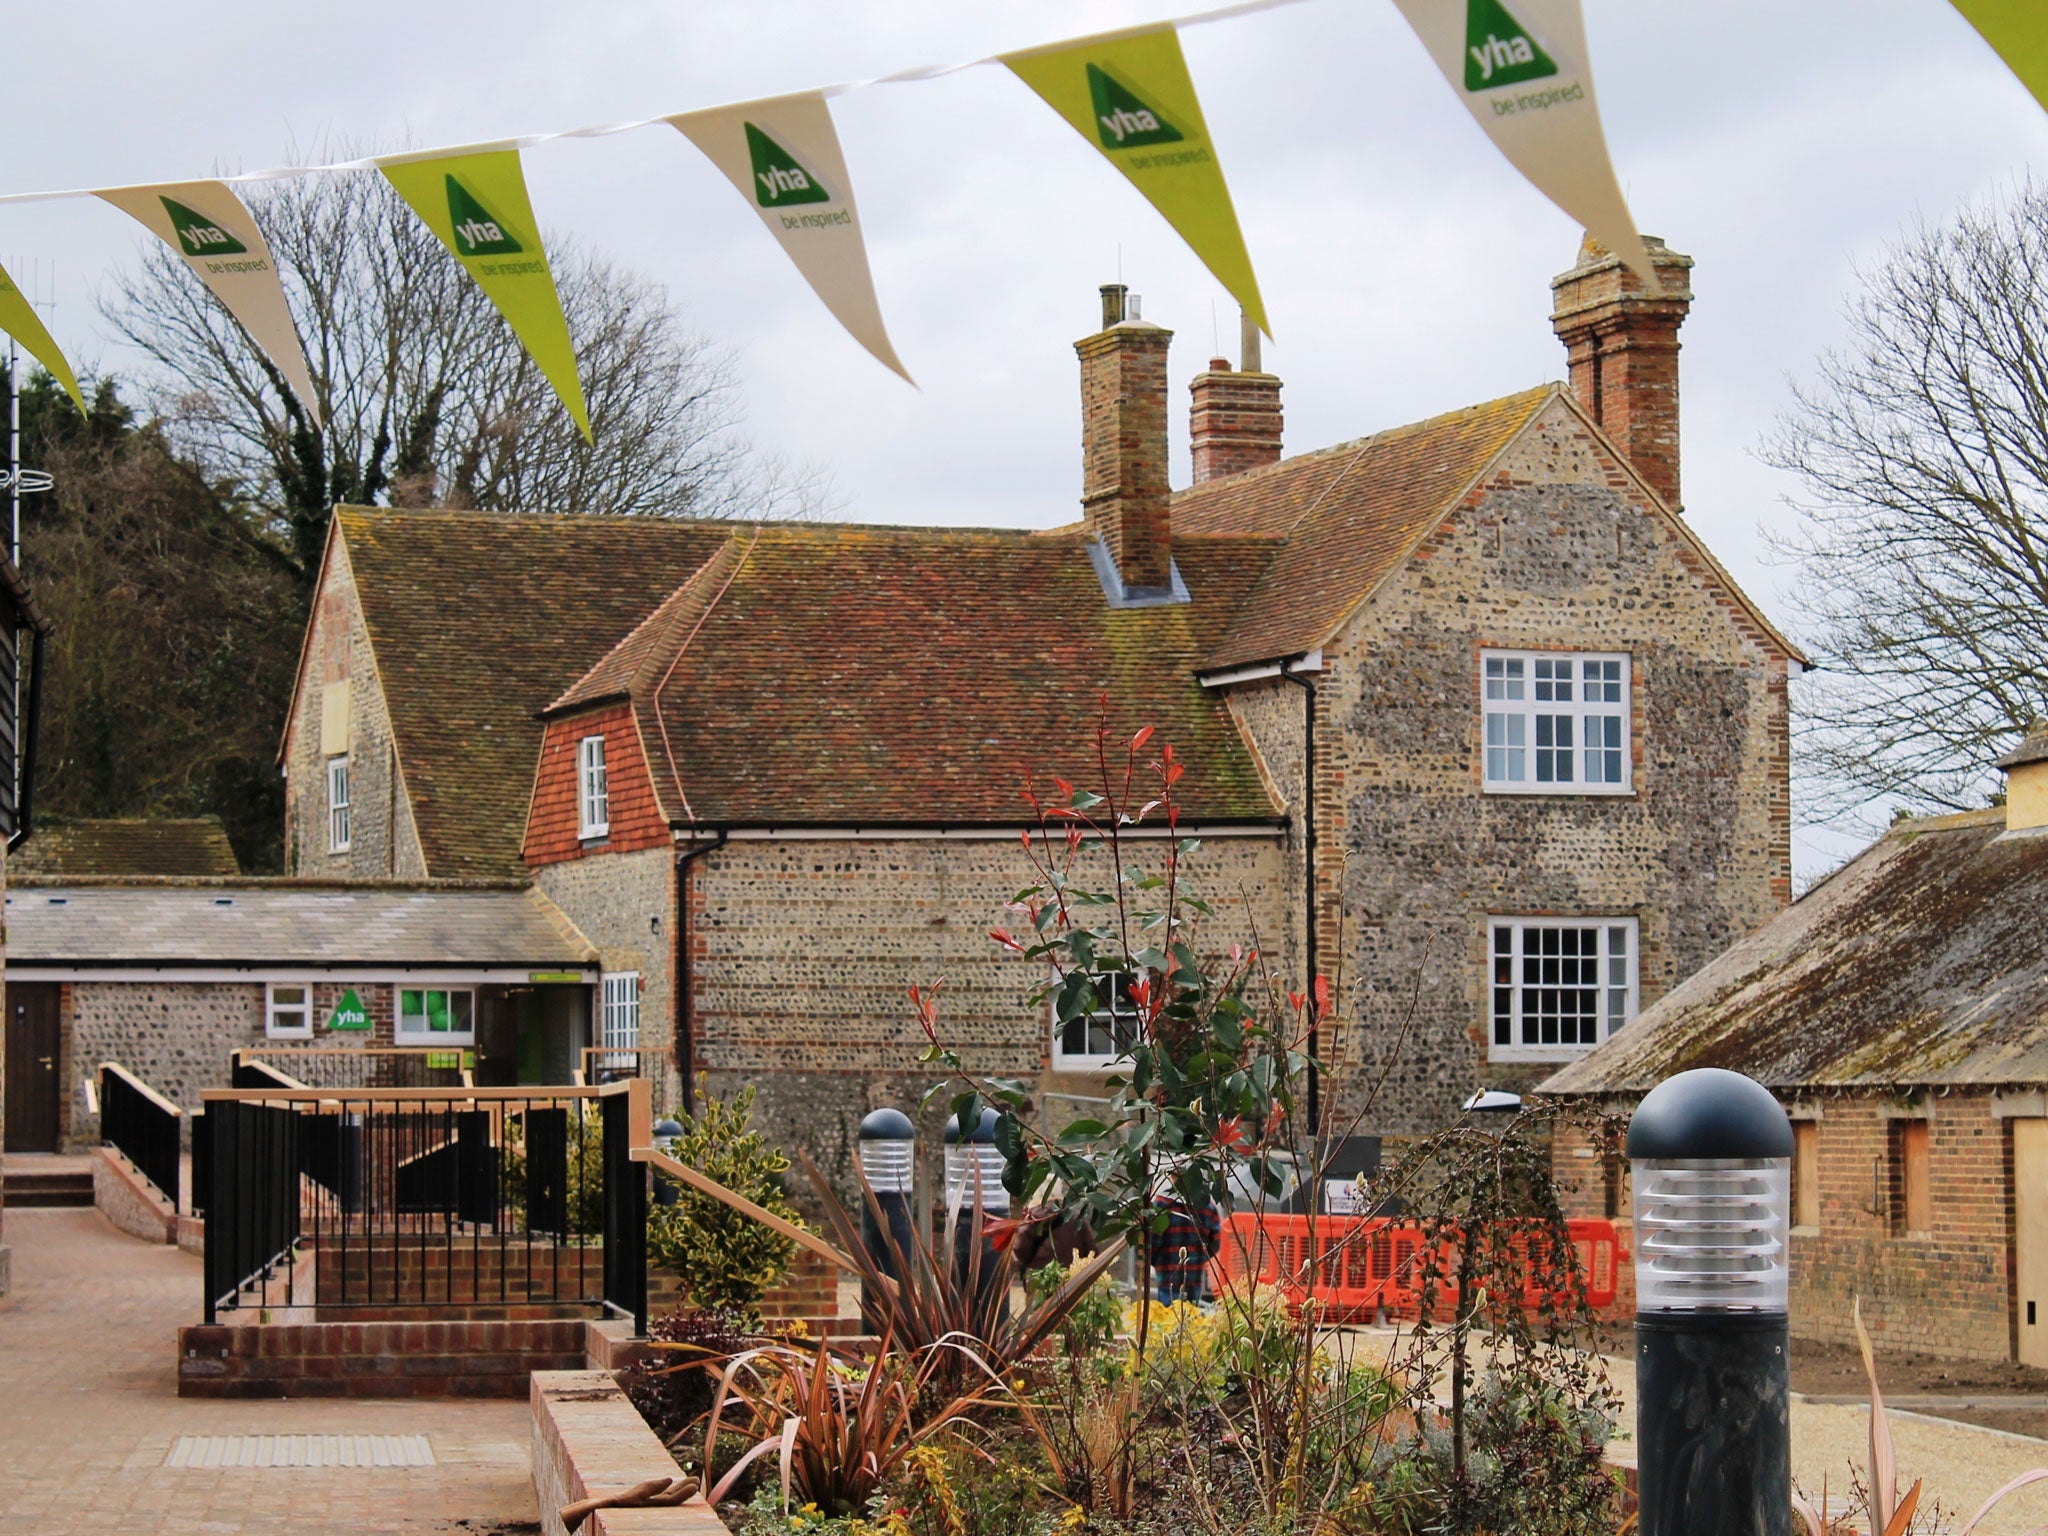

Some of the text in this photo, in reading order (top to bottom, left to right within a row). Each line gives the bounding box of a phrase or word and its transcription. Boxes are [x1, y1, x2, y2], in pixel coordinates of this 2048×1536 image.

[1471, 33, 1535, 79] yha
[1491, 80, 1584, 115] be inspired
[1101, 107, 1160, 141] yha
[1152, 148, 1209, 167] inspired
[758, 165, 810, 199] yha
[781, 208, 851, 229] be inspired
[180, 224, 228, 250] yha
[456, 218, 505, 249] yha
[205, 257, 269, 274] be inspired
[498, 260, 544, 276] inspired
[337, 1009, 365, 1026] yha
